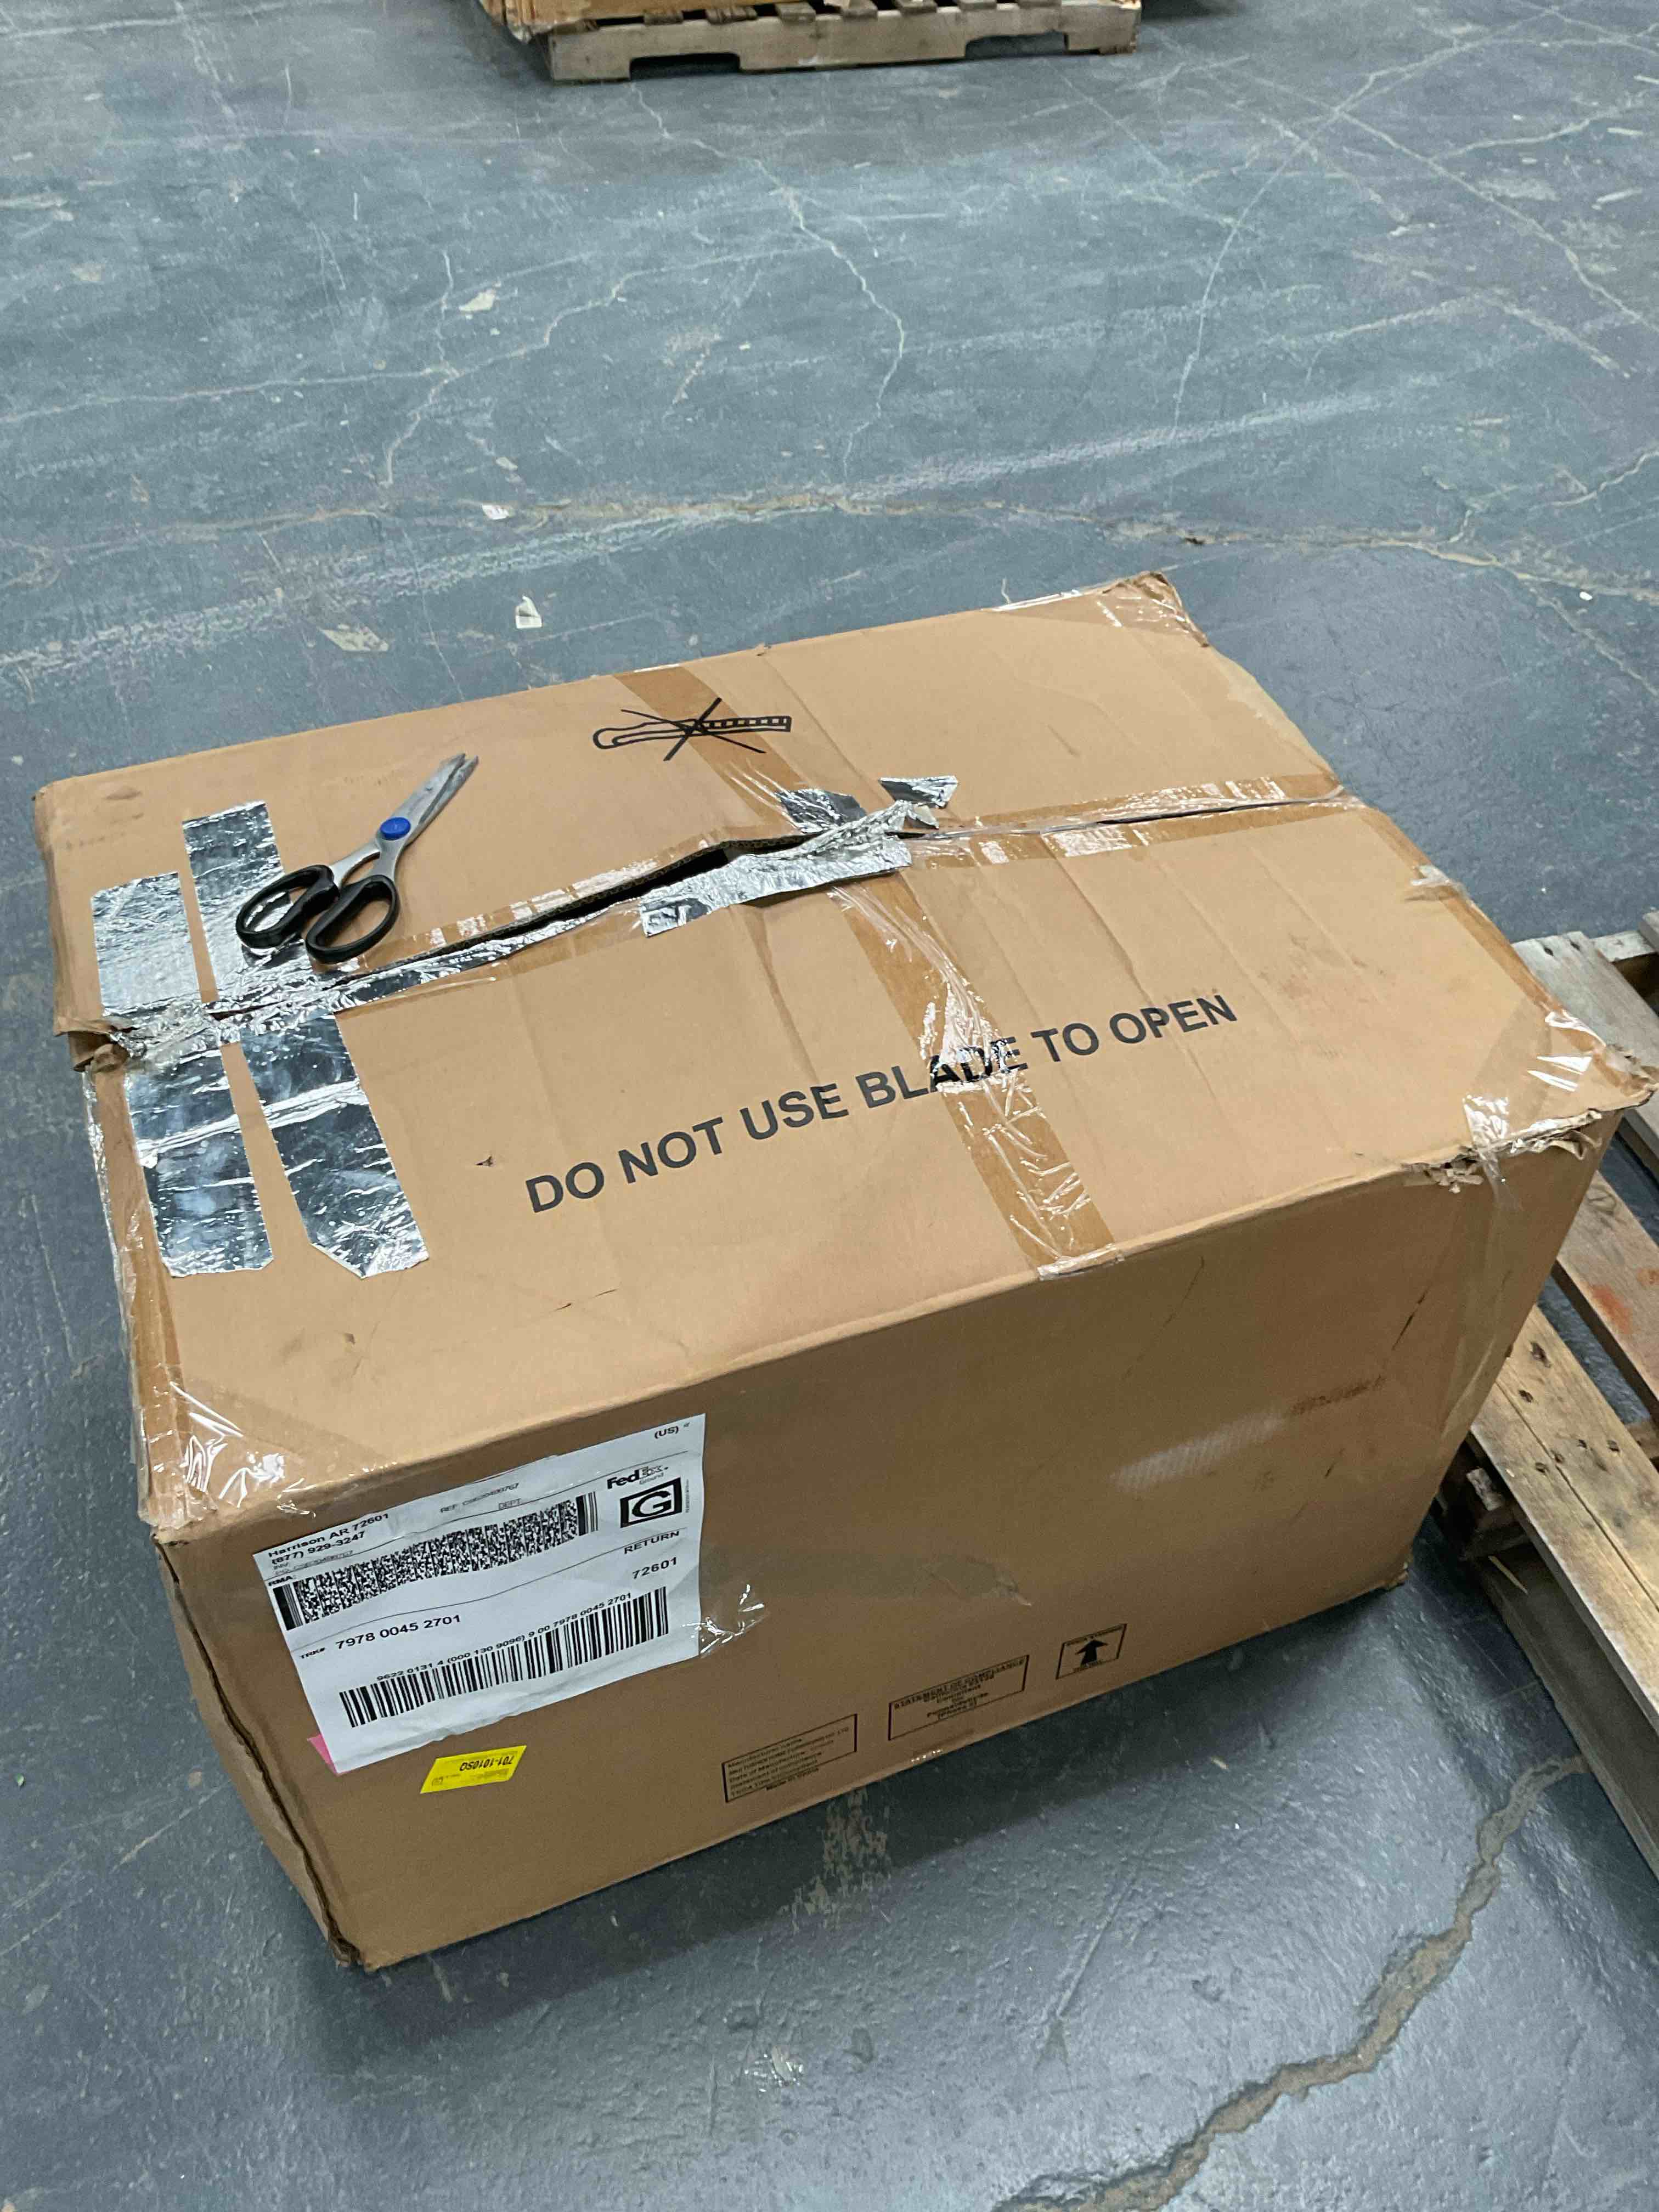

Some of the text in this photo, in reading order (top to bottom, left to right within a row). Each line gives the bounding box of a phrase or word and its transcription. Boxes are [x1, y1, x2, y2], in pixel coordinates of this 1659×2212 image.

[525, 995, 1237, 1213] DO NOT USE BLADE TO OPEN
[654, 1426, 679, 1439] (US)
[607, 1465, 663, 1489] FedEx
[632, 1491, 672, 1517] G
[269, 1513, 389, 1557] Harrison AR 72601
[272, 1551, 303, 1565] (877)
[308, 1531, 365, 1554] 929-3247
[624, 1531, 680, 1554] RETURN
[632, 1557, 677, 1579] 72601
[336, 1633, 376, 1649] 7978
[380, 1622, 419, 1638] 0045
[424, 1615, 461, 1629] 2701
[407, 1663, 432, 1673] 0131
[447, 1652, 471, 1664] (000
[474, 1646, 493, 1655] 130
[495, 1635, 525, 1649] 9096)
[538, 1625, 550, 1634] 00
[553, 1613, 578, 1627] 7978
[580, 1602, 605, 1616] 0045
[607, 1593, 631, 1605] 2701
